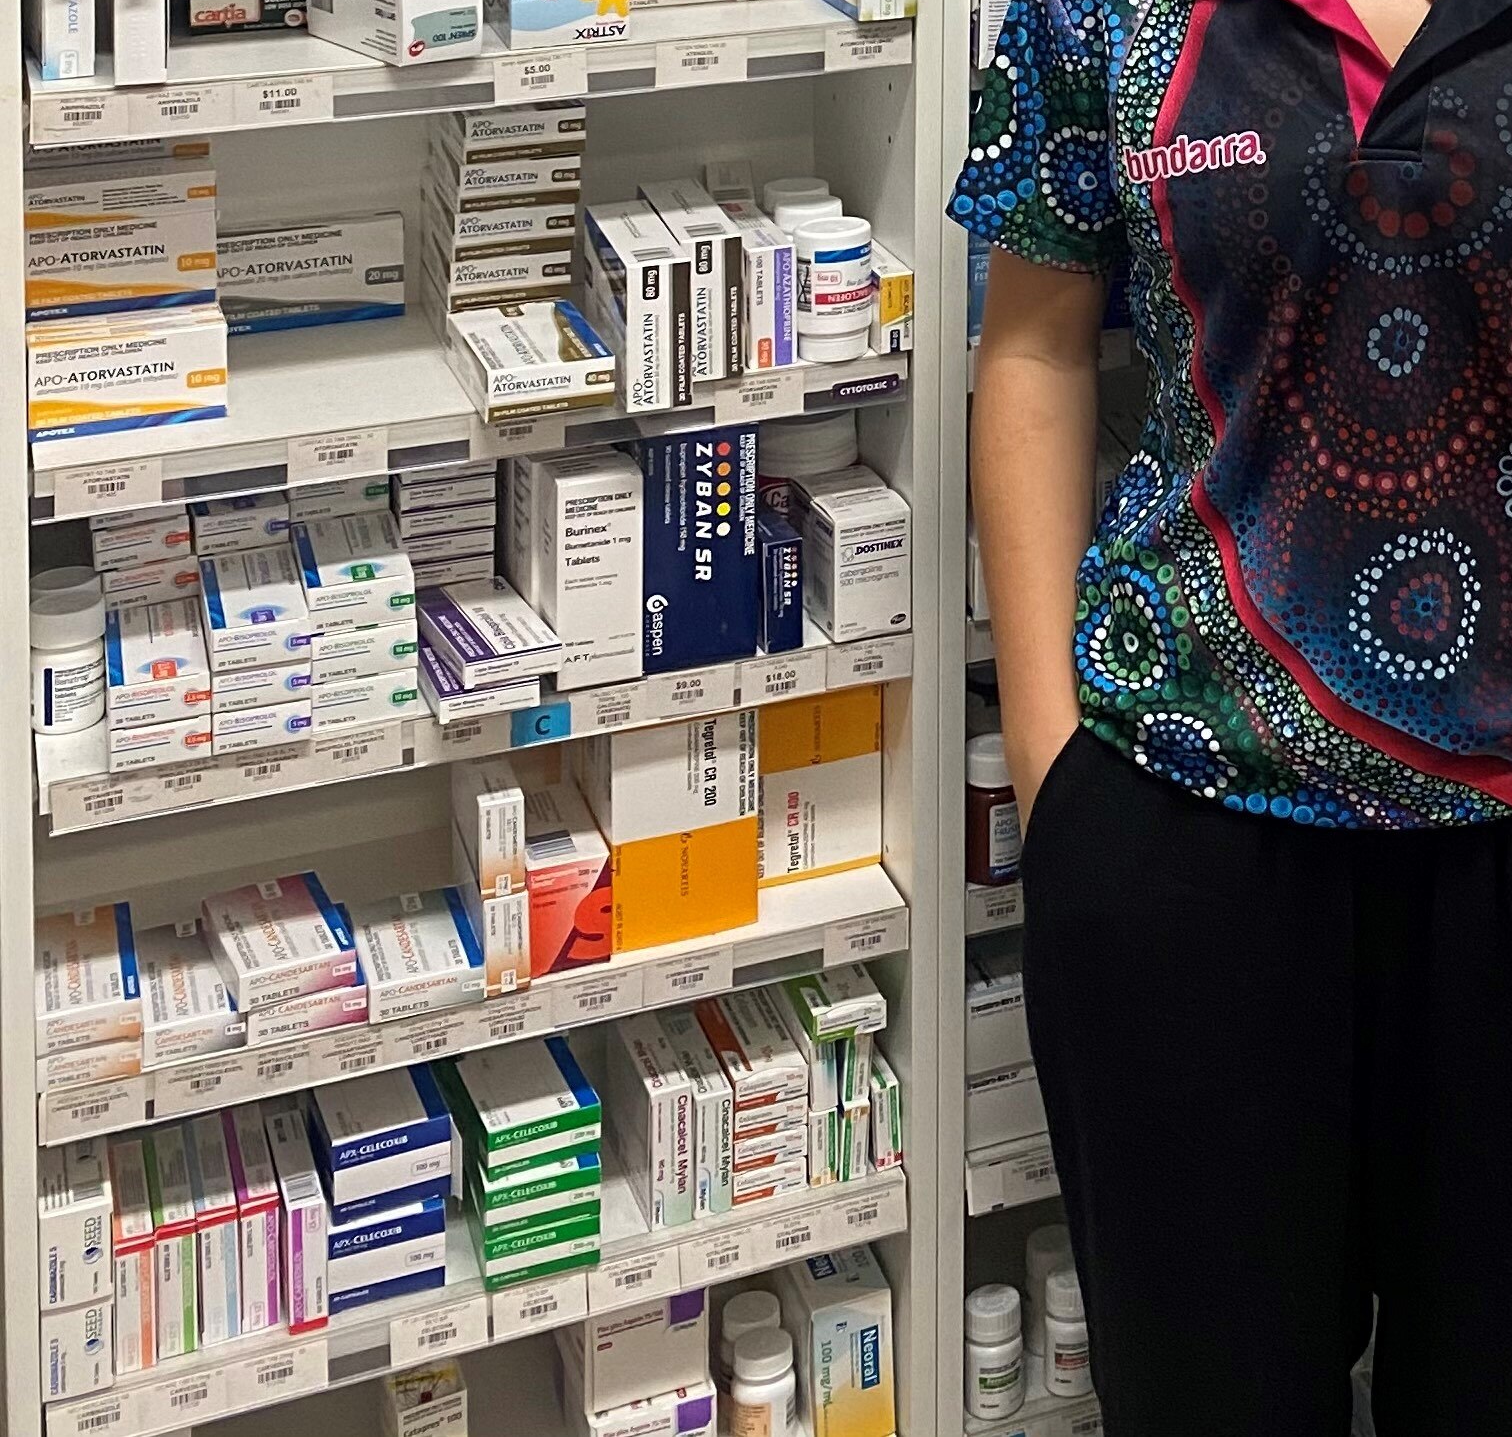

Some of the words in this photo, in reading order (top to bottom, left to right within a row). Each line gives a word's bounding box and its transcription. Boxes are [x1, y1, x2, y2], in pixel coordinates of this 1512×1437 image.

[193, 3, 247, 25] cartia
[574, 23, 627, 41] ASTRIX
[523, 63, 552, 75] $5.00
[261, 87, 298, 100] $11.00
[470, 122, 546, 138] ATORVASTATIN
[1123, 129, 1266, 183] bundarra.
[463, 171, 539, 186] ATORVASTATIN
[458, 219, 534, 234] ATORVASTATIN
[27, 244, 166, 269] APO-ATORVASTATIN
[454, 266, 530, 281] ATORVASTATIN
[695, 286, 707, 376] ATORVASTATIN
[642, 312, 654, 406] ATORVASTATIN
[33, 361, 175, 389] APO-ATORVASTATIN
[492, 375, 573, 393] ATORVASTATIN
[838, 379, 888, 398] CYTOTOXIC
[695, 441, 714, 541] ZYBAN
[564, 524, 608, 539] Burinex
[855, 537, 905, 557] DOSTINEX
[564, 553, 601, 568] Tablets
[694, 549, 713, 582] SR
[650, 614, 663, 658] aspen
[674, 678, 702, 691] $9.00
[533, 714, 552, 737] C
[703, 717, 718, 759] Tegretol
[704, 766, 717, 784] CR
[703, 784, 717, 808] 200
[786, 790, 800, 809] 400
[786, 809, 799, 828] CR
[786, 832, 800, 874] Tegretol
[676, 1094, 689, 1151] Cinacalcet
[720, 1098, 732, 1154] Cinacalcet
[338, 1134, 409, 1161] APX-CELECOXIB
[676, 1153, 688, 1195] Mylan
[719, 1155, 731, 1188] Mylan
[490, 1180, 558, 1206] APX-CELECOXIB
[83, 1216, 97, 1253] SEED
[331, 1225, 403, 1250] APX-CELECOXIB
[84, 1309, 98, 1345] SEED
[820, 1338, 833, 1362] 100
[860, 1327, 876, 1384] Neoral
[820, 1364, 834, 1409] mg/mL
